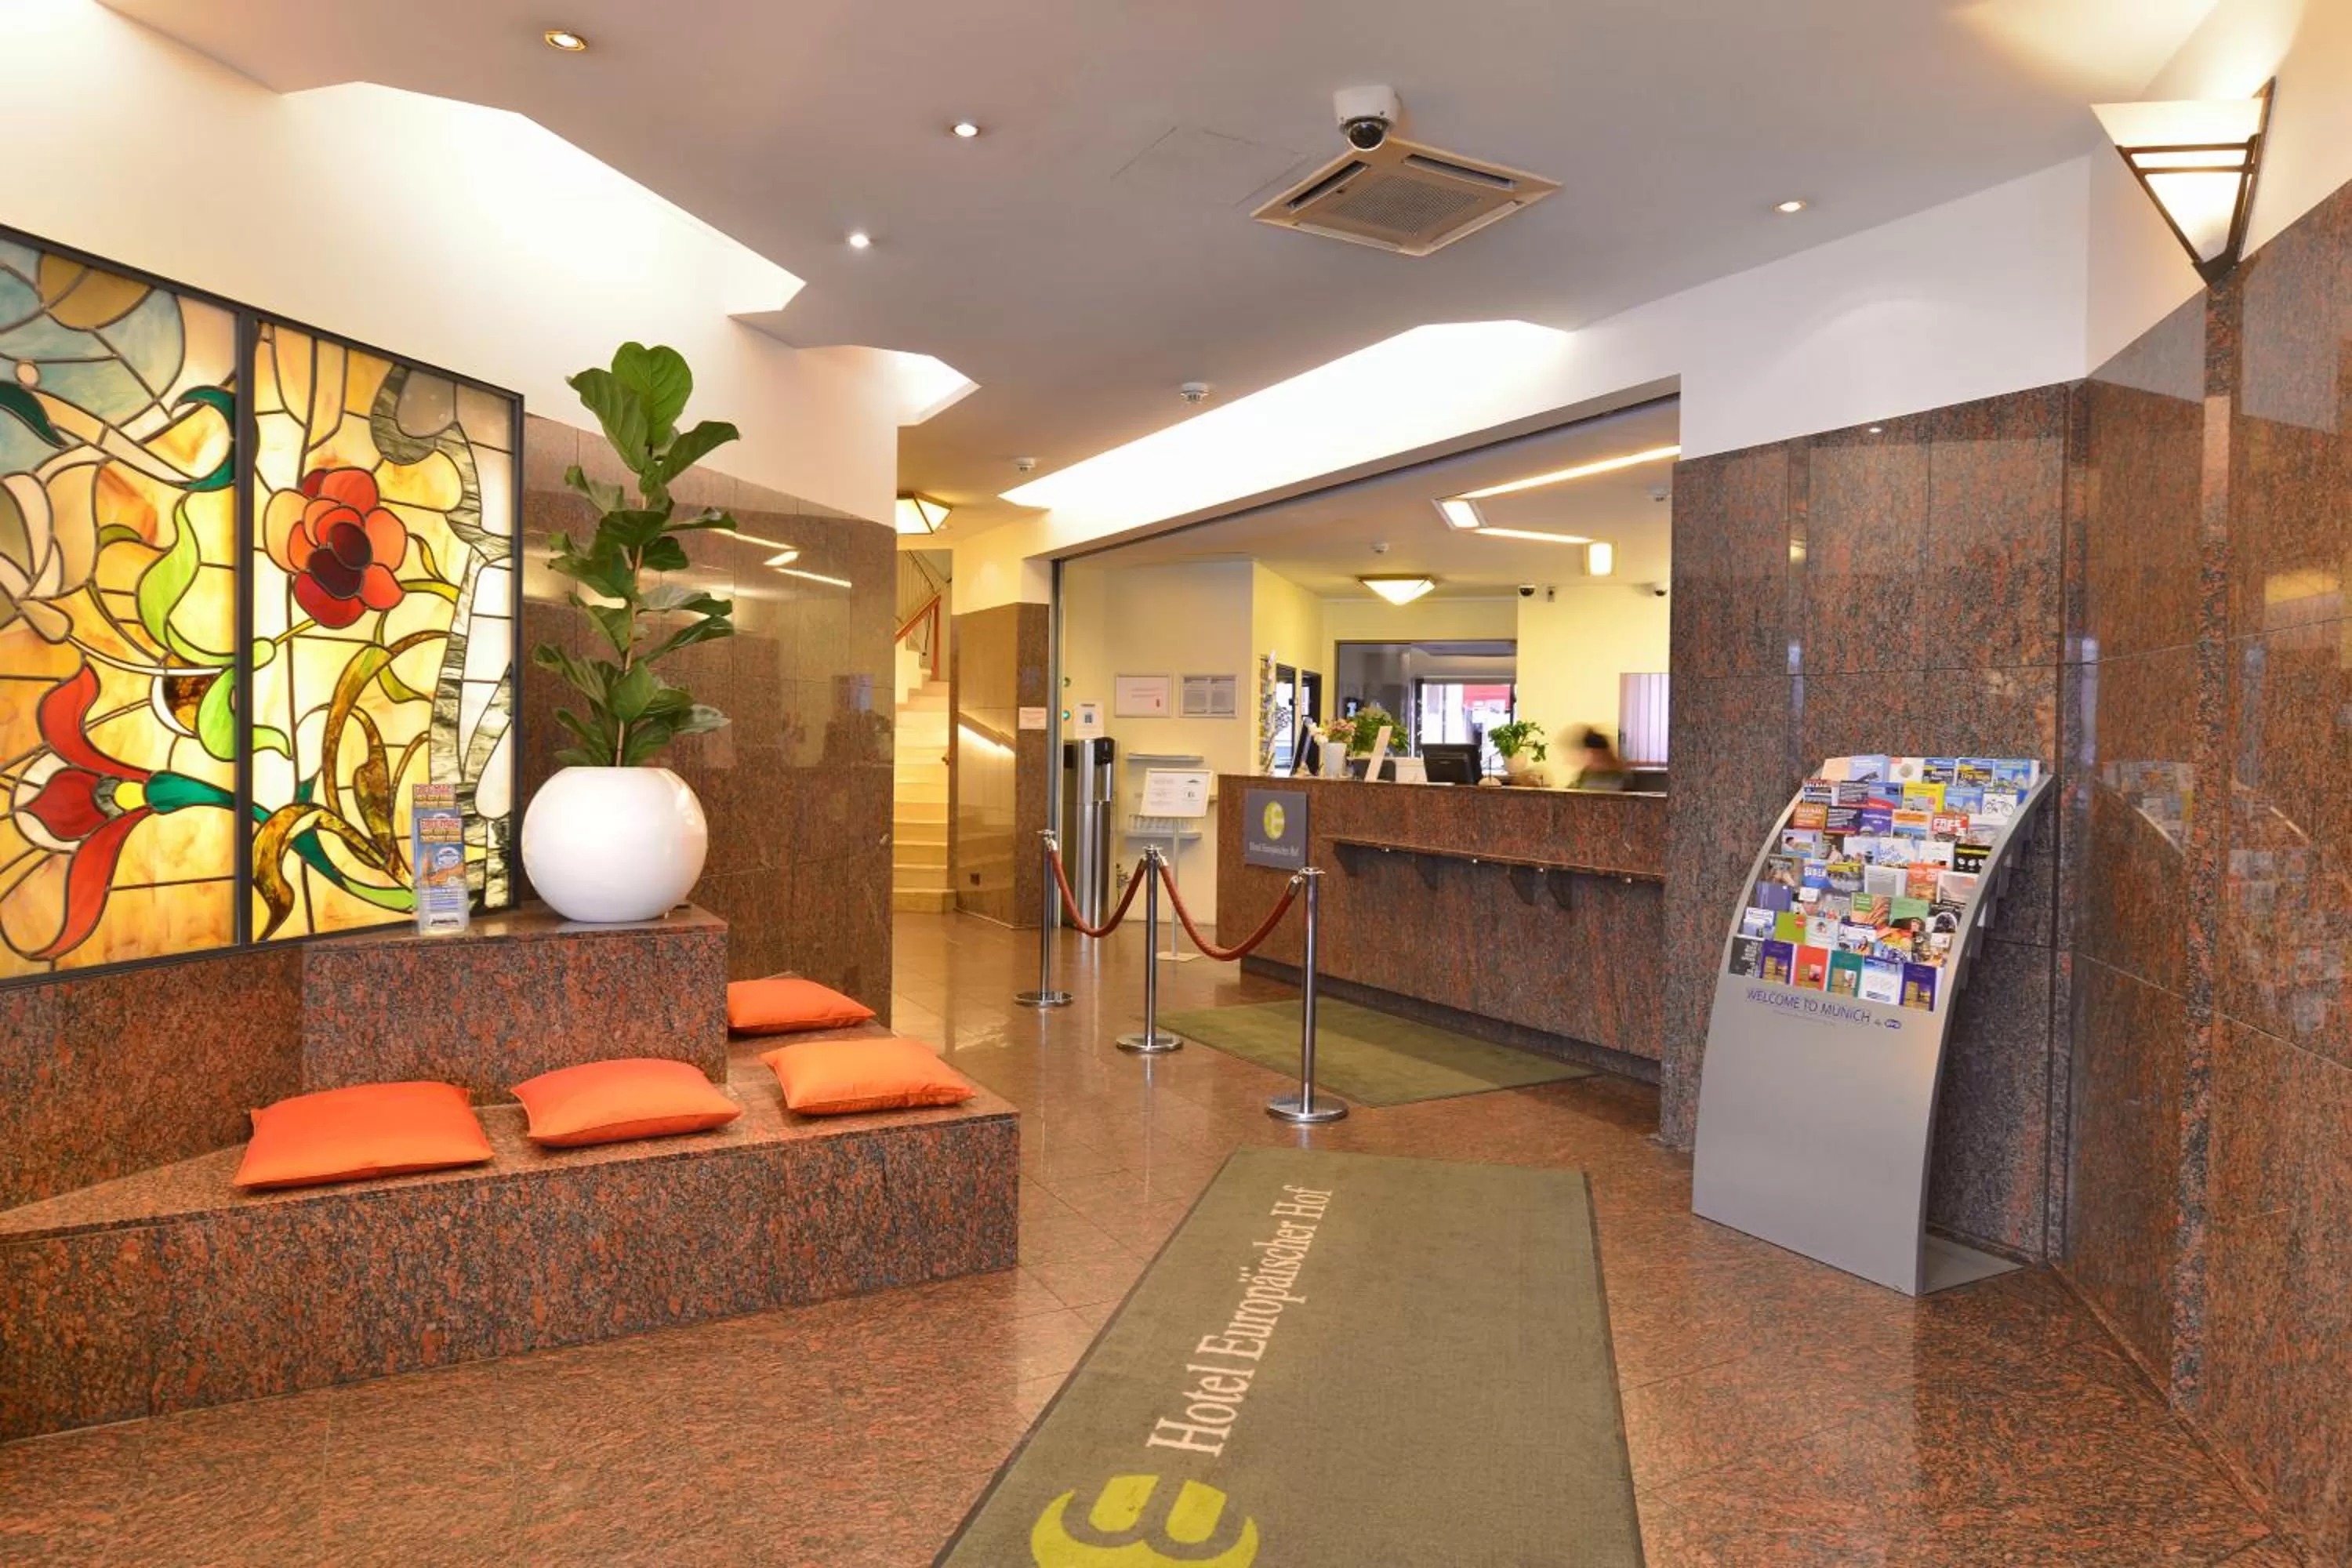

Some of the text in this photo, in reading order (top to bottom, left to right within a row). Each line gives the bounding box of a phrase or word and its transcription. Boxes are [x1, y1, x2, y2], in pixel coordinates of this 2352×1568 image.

[1747, 990, 1800, 1008] WELCOME
[1804, 1000, 1818, 1012] TO
[1820, 1003, 1871, 1022] MUNICH
[1145, 1185, 1332, 1457] Hotel Europäischer Hof
